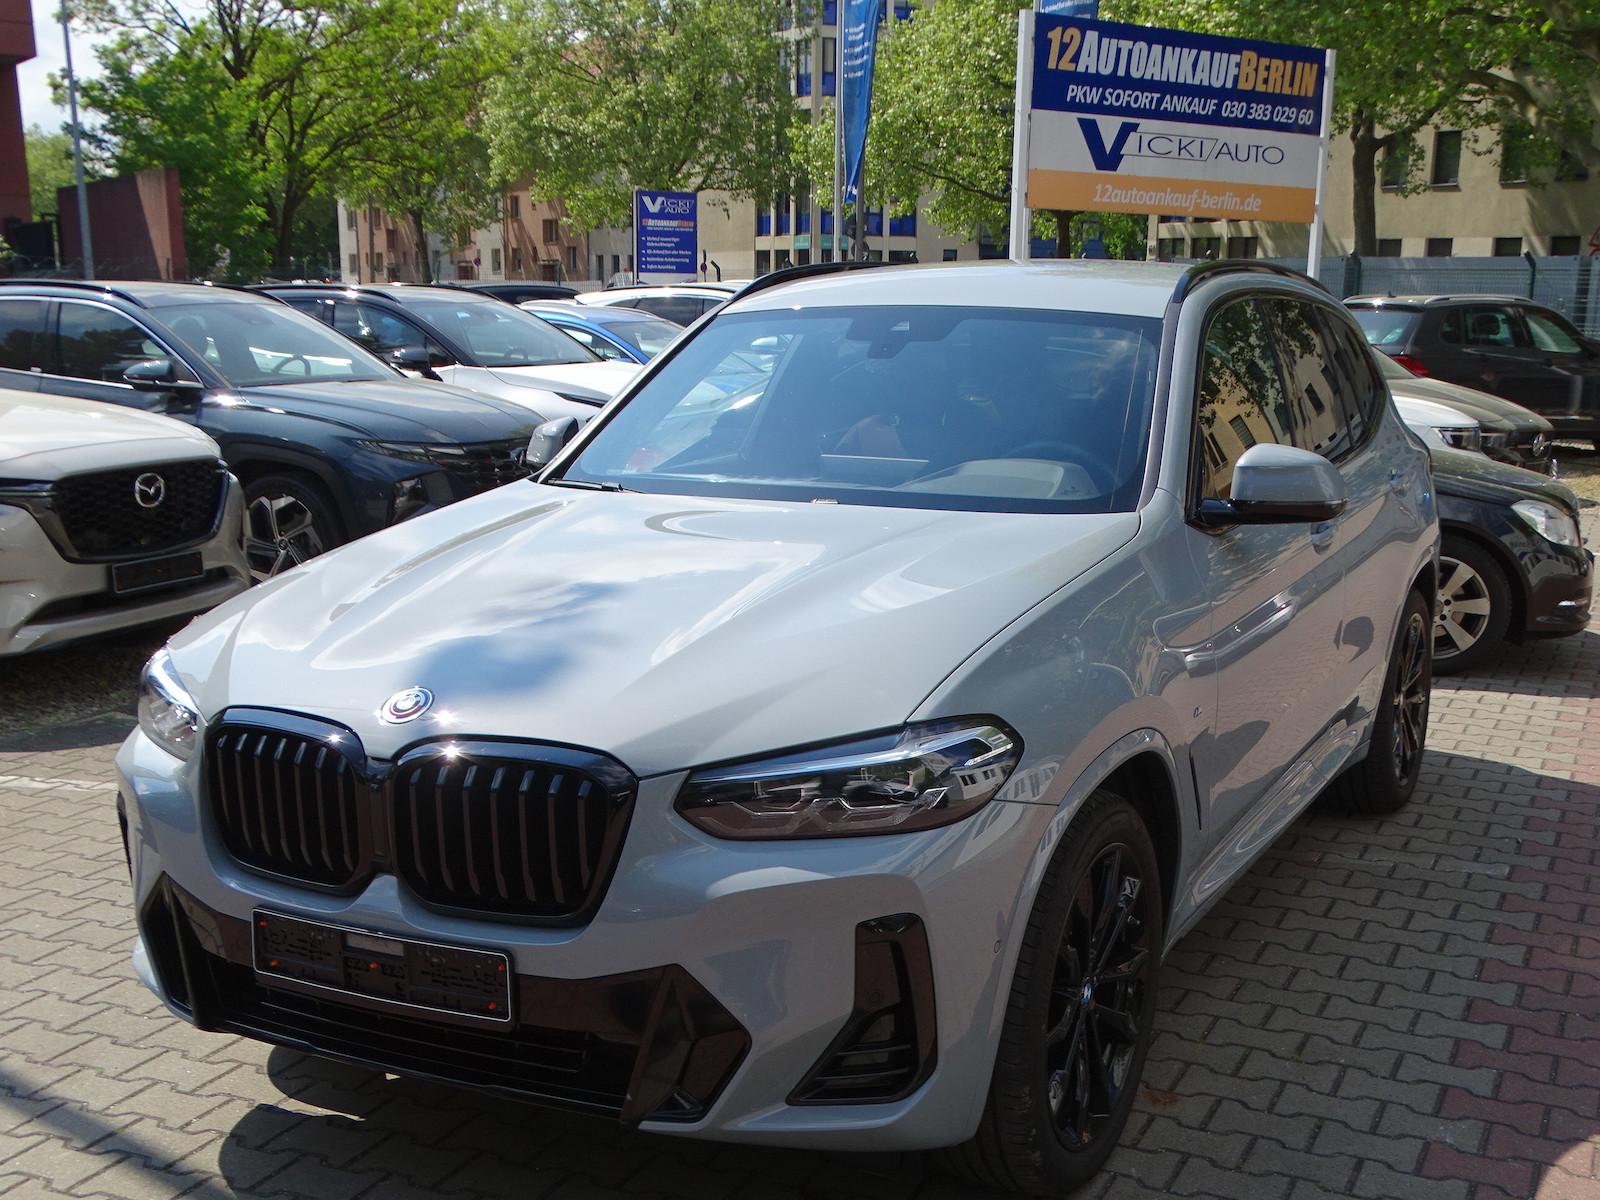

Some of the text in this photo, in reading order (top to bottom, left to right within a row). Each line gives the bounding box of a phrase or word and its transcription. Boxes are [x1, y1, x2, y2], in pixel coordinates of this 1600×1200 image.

[1067, 84, 1314, 126] PKW SOFORT ANKAUF 030 383 029 60
[1214, 141, 1285, 165] AUTO
[1093, 183, 1262, 212] 12autoankauf-berlin.de
